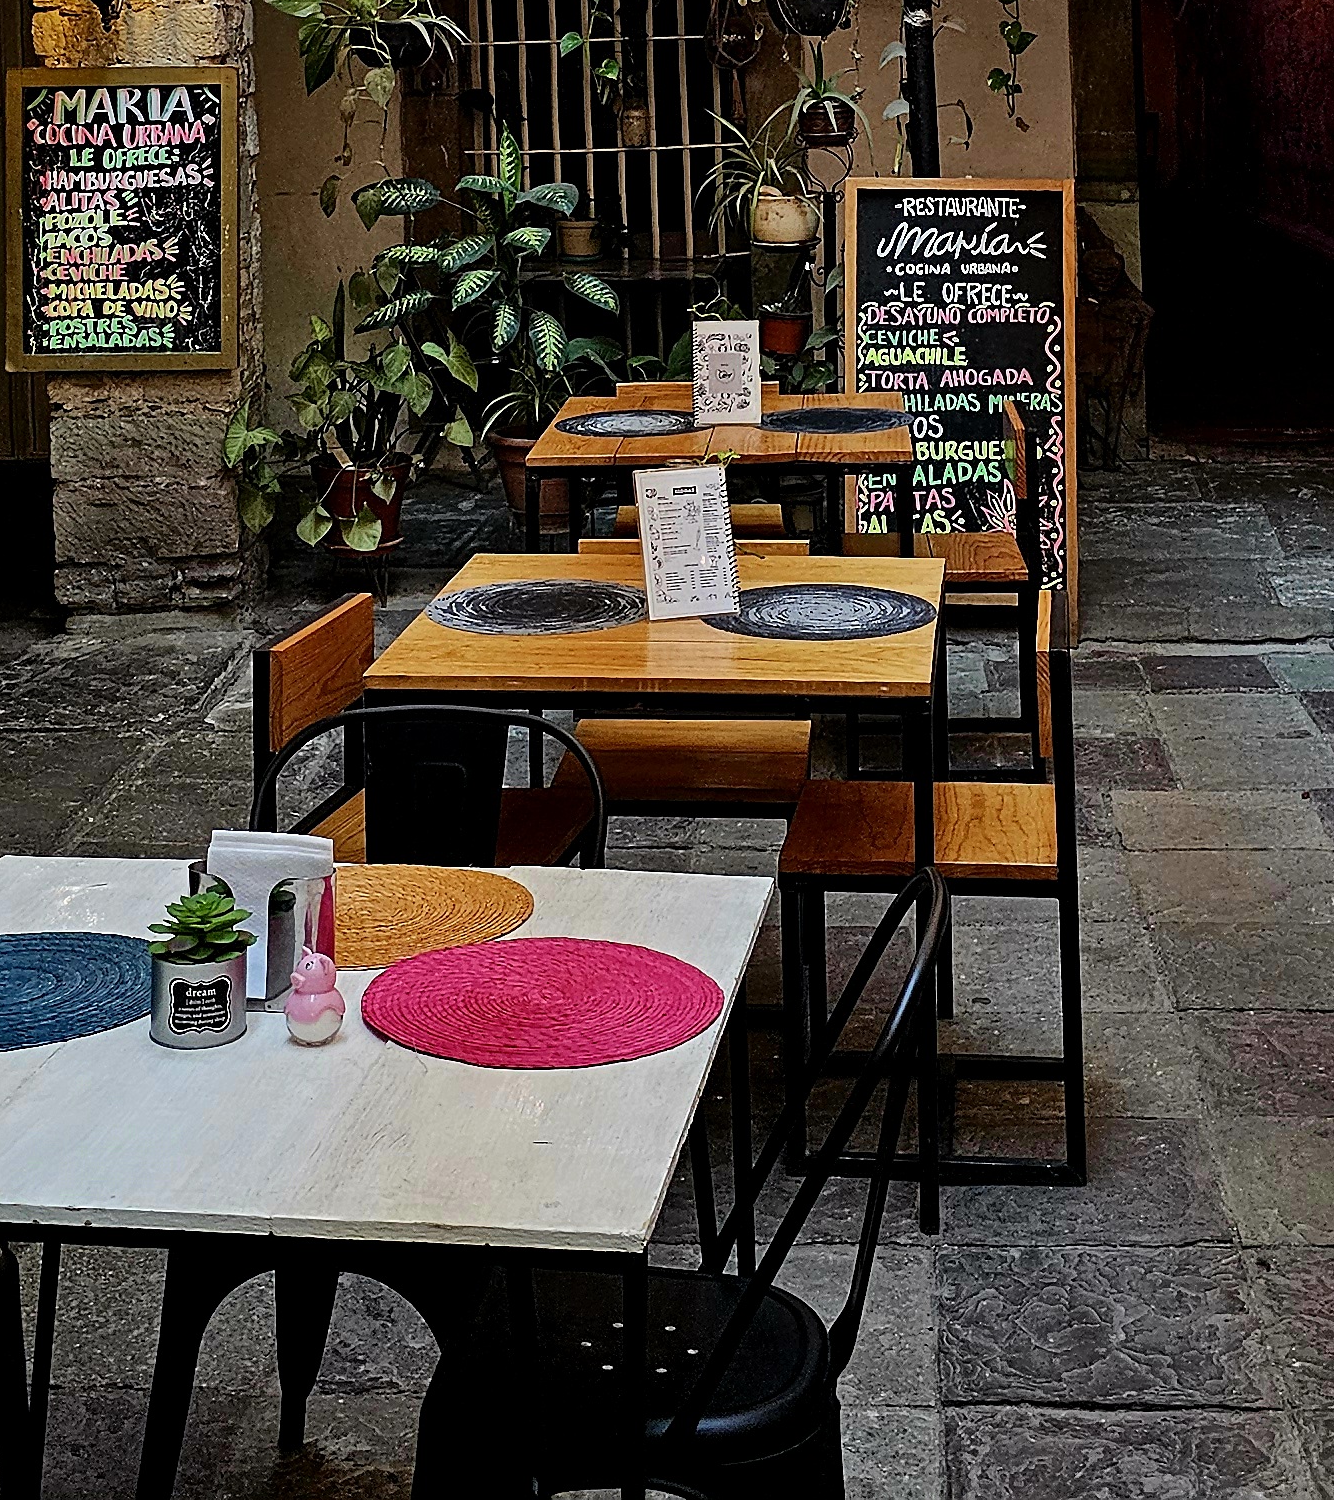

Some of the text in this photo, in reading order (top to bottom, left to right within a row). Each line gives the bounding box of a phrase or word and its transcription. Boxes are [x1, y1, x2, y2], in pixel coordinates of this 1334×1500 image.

[53, 86, 195, 125] MARIA
[33, 120, 205, 148] COCINA URBANA
[70, 148, 94, 166] LE
[45, 164, 201, 190] HAMBURGUESAS
[44, 190, 120, 212] ALITAS
[45, 209, 128, 230] POZOLE
[44, 225, 112, 248] TACOS
[47, 239, 163, 264] ENCHILADAS
[46, 264, 129, 281] CEVICHE
[895, 262, 1011, 276] COCINA URBANA
[48, 278, 169, 300] MICHELADAS
[900, 282, 1013, 307] LE OFRECE
[47, 301, 178, 318] COPA DE VINO
[867, 306, 1050, 326] DESAYUNO COMPLETO
[50, 315, 137, 335] POSTRES
[50, 328, 162, 349] ENSALADAS
[866, 328, 940, 346] CEVICHE
[865, 347, 968, 366] AGUACHILE
[865, 368, 1034, 390] TORTA AHOGADA
[903, 393, 981, 413] HILADAS
[868, 461, 1002, 489] ENALADAS
[869, 488, 956, 513] PATAS
[185, 988, 217, 997] dream
